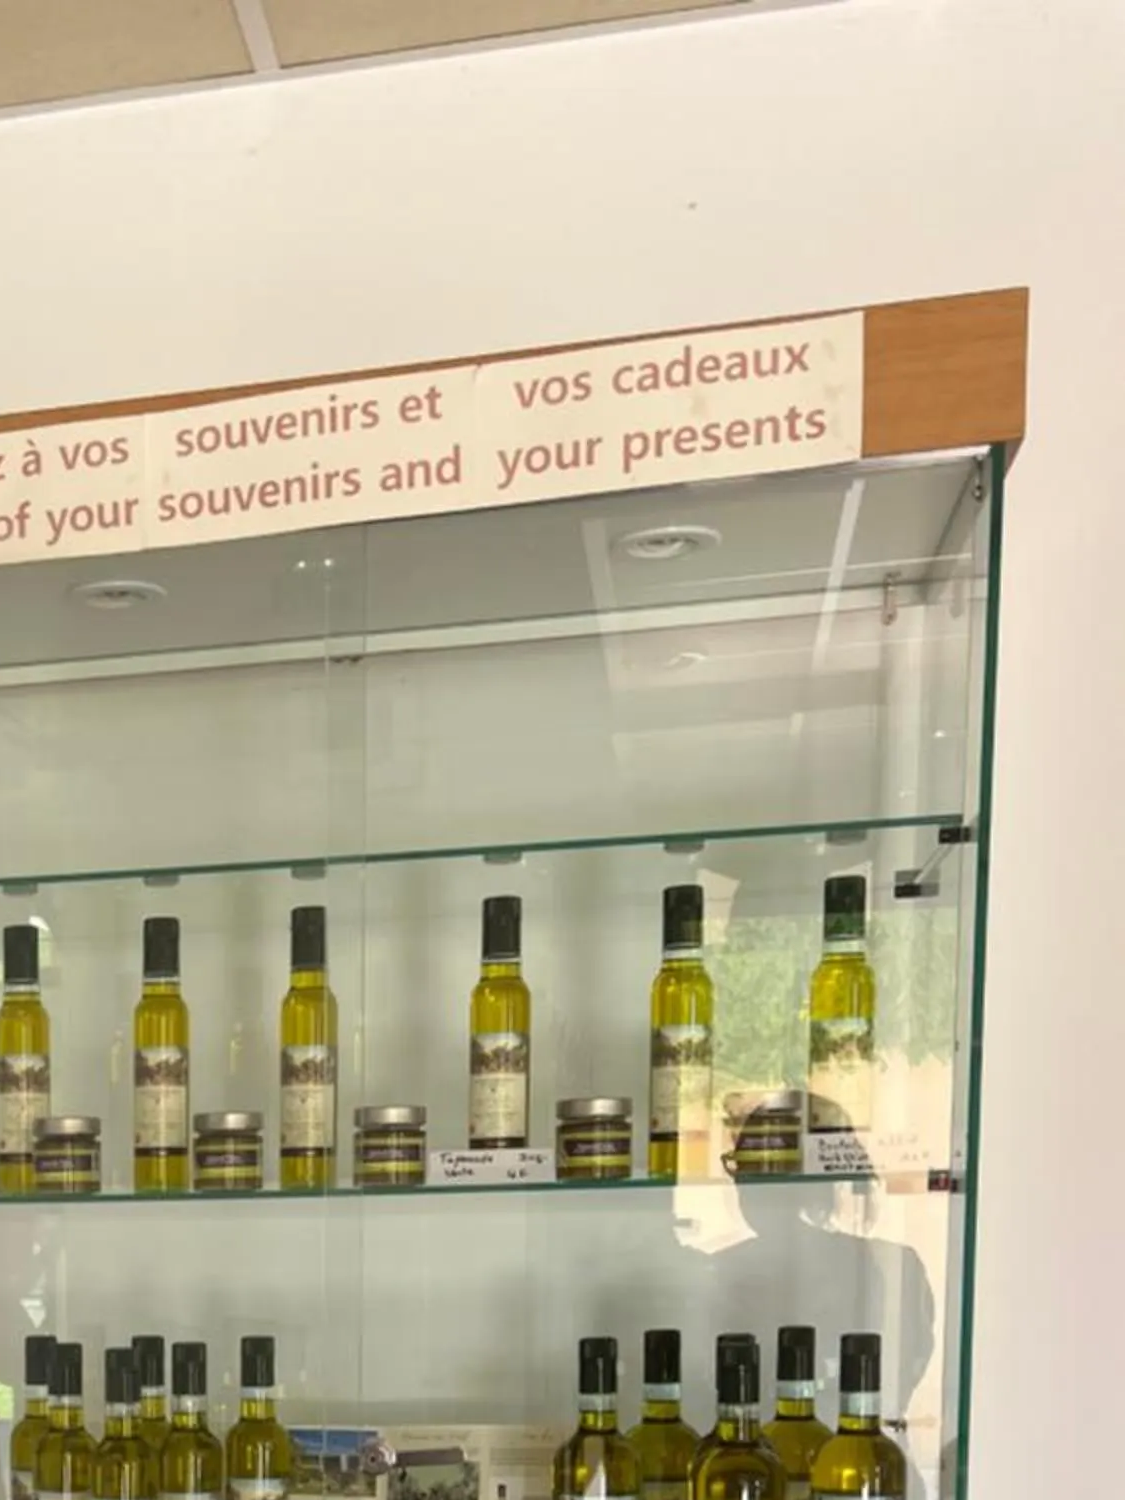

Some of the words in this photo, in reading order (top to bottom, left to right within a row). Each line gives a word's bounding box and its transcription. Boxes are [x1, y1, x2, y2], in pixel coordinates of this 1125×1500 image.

[20, 439, 43, 478] à
[58, 436, 130, 471] vos
[175, 393, 381, 458] souvenirs
[398, 384, 443, 424] et
[513, 370, 593, 410] vos
[611, 342, 810, 396] cadeaux
[45, 497, 140, 547] your
[158, 461, 363, 523] souvenirs
[378, 443, 463, 493] and
[496, 436, 604, 491] your
[622, 404, 828, 475] presents
